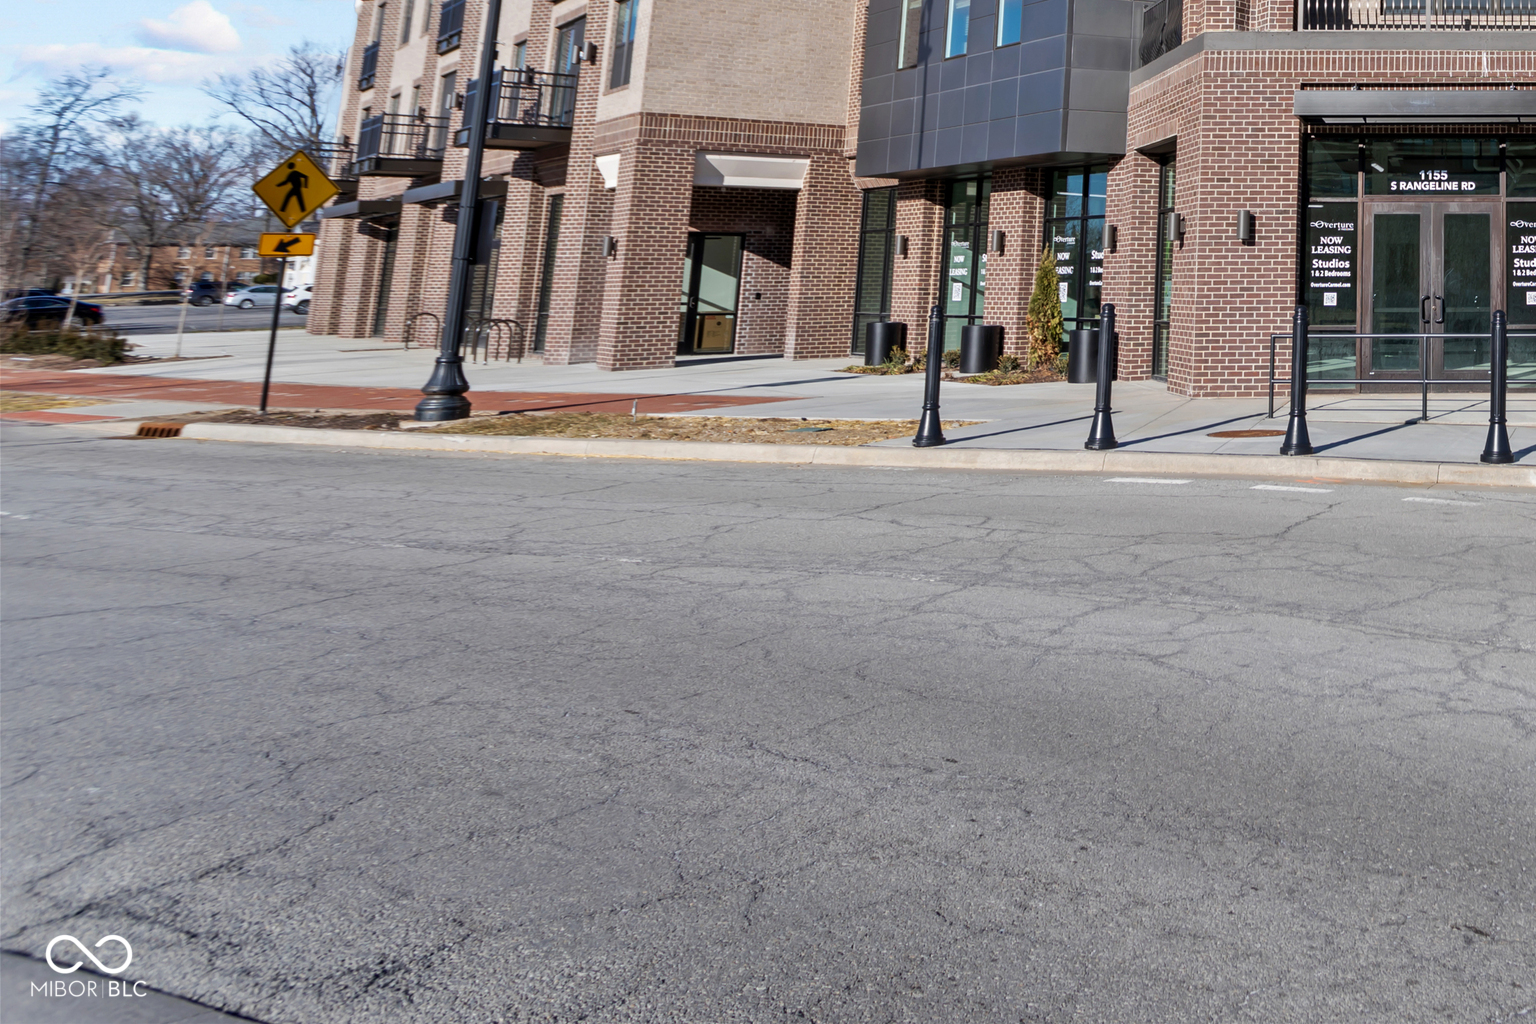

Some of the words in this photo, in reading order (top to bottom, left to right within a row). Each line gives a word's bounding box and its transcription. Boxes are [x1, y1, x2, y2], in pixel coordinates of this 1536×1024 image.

[1419, 170, 1448, 180] 1155
[1390, 181, 1398, 190] S
[1400, 181, 1458, 190] RANGELINE
[1461, 181, 1476, 190] RD
[1315, 220, 1354, 228] Overture
[1320, 237, 1343, 245] NOW
[1311, 246, 1352, 254] LEASING
[1057, 252, 1071, 261] NOW
[1312, 259, 1350, 268] Studios
